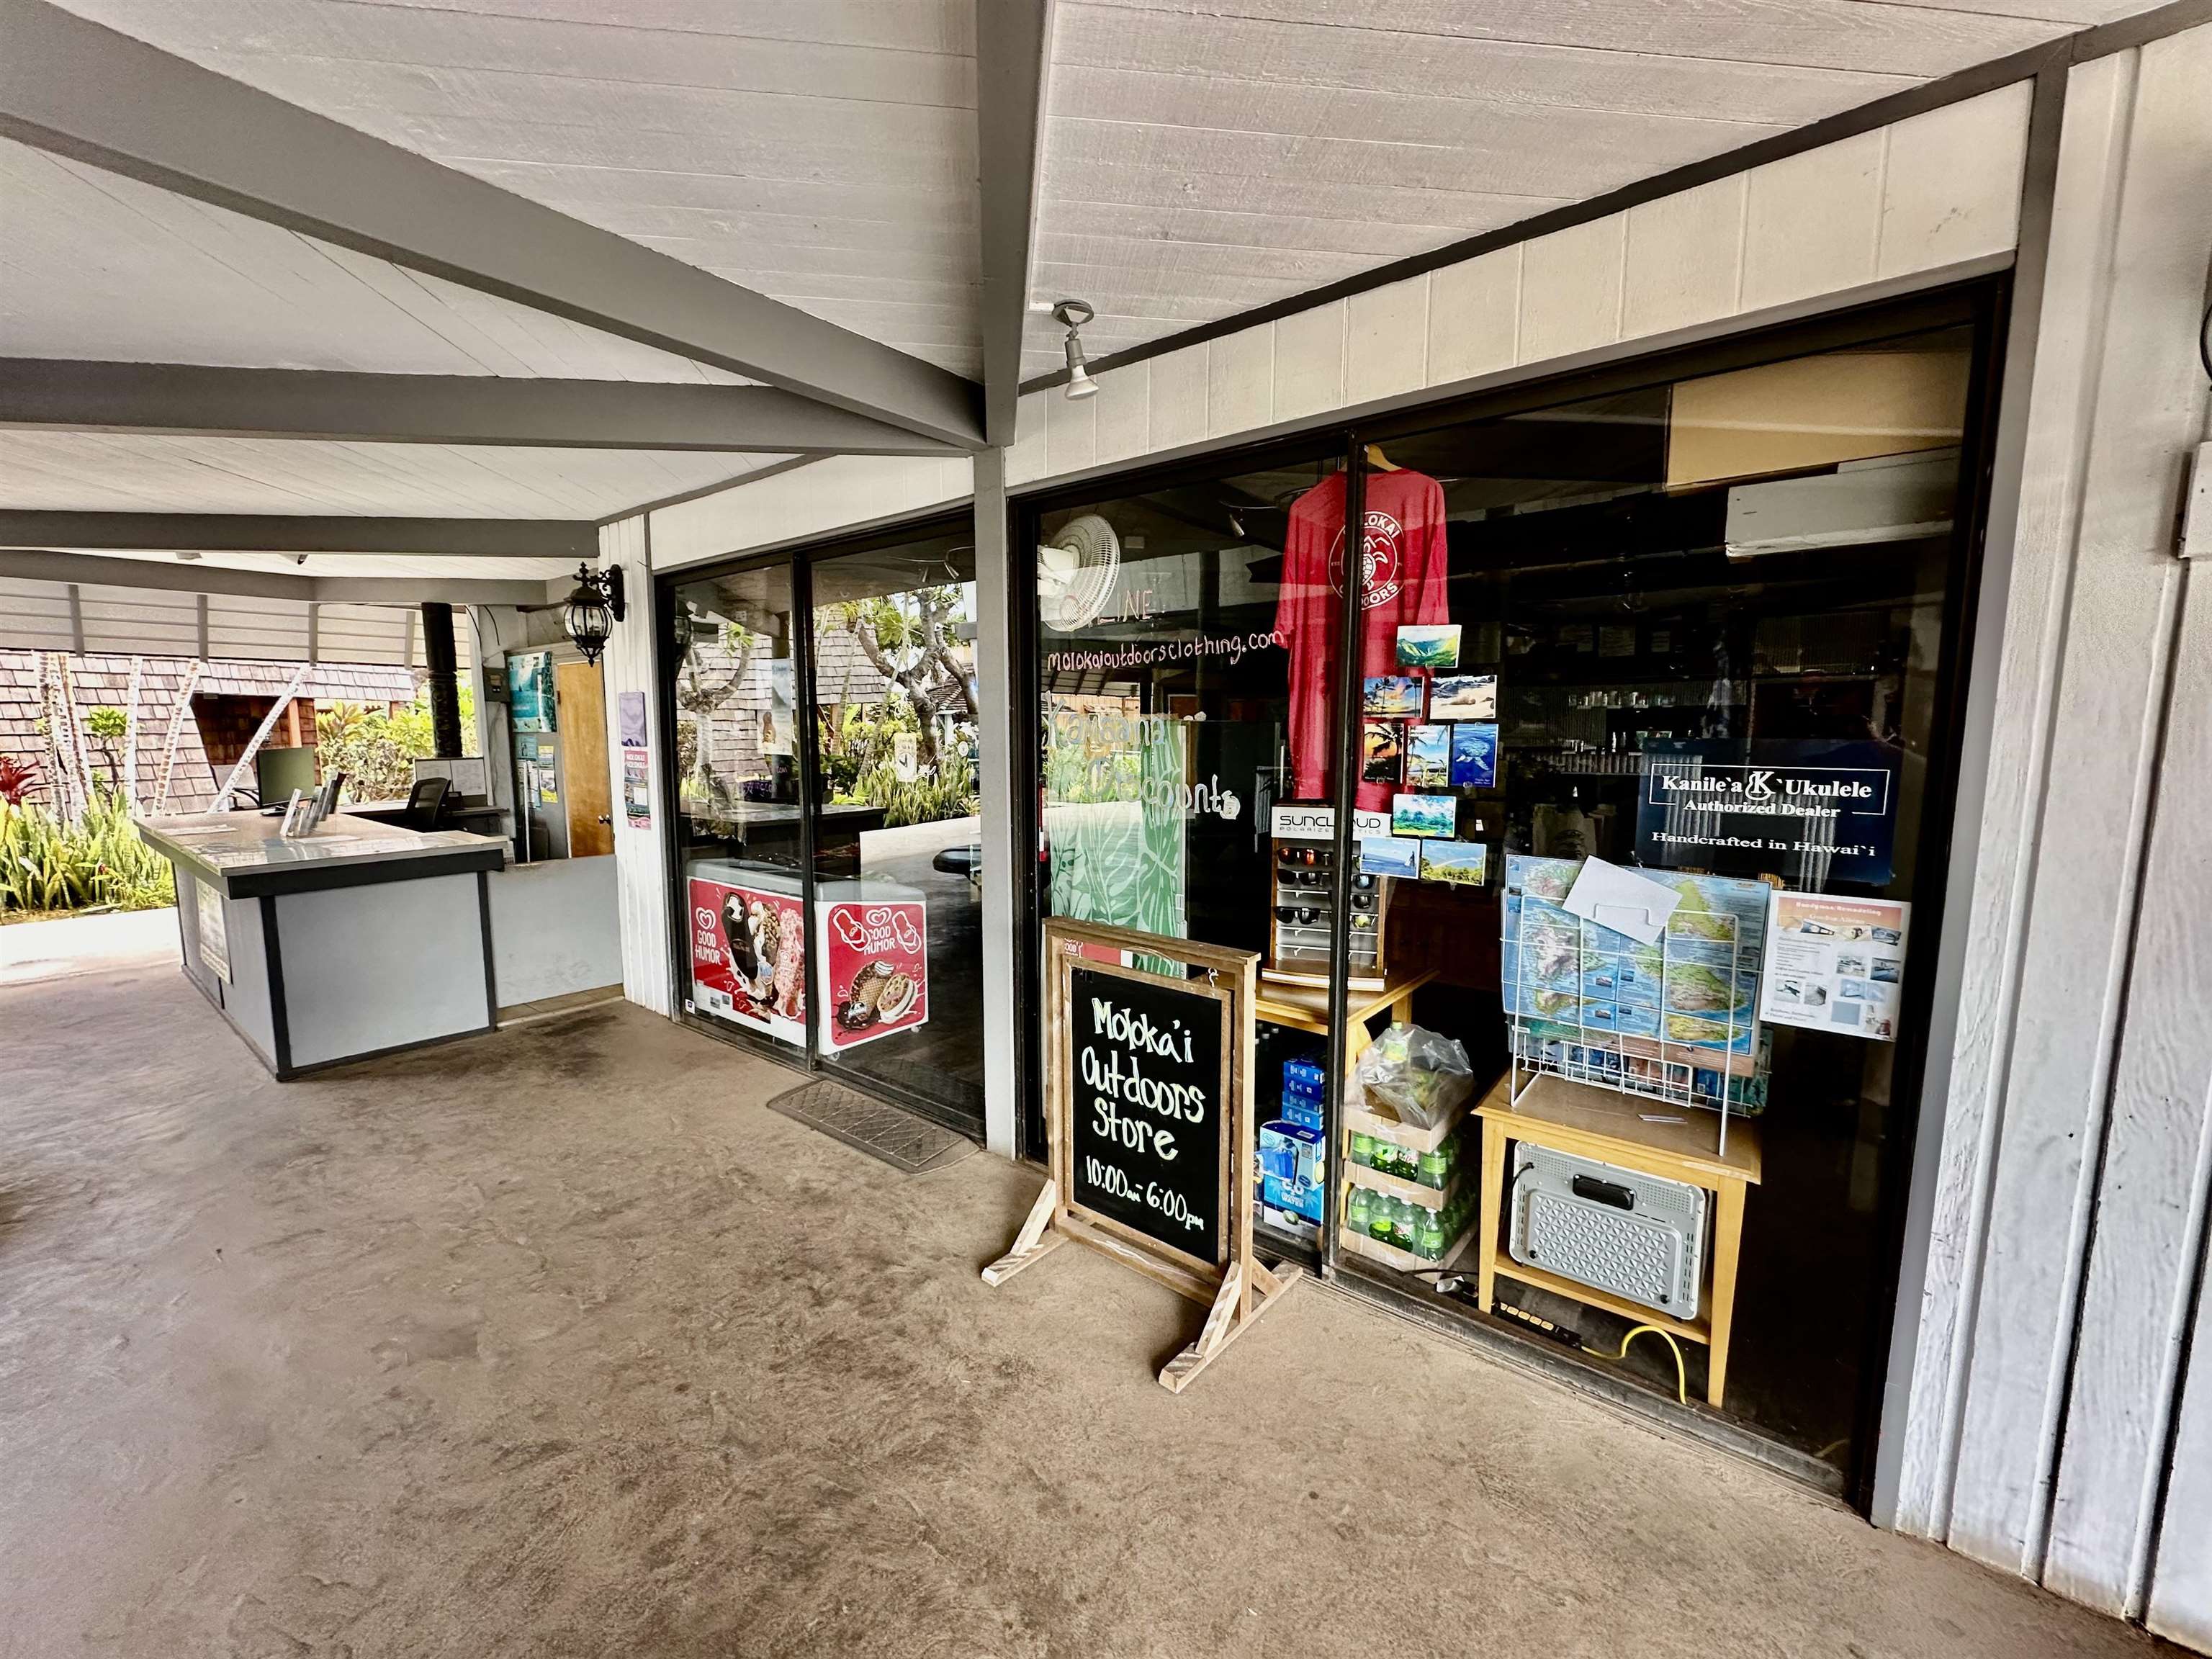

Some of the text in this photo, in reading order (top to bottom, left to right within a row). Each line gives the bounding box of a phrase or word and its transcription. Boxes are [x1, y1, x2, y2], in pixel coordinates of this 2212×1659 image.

[1683, 800, 1841, 818] Authorized Dealer
[1280, 815, 1381, 829] SUNCLUD
[1651, 832, 1763, 849] Handcrafted
[1768, 840, 1787, 850] in
[697, 930, 717, 948] GOOD
[695, 945, 722, 966] HUMOR
[1092, 997, 1194, 1063] Moloka'i
[1082, 1046, 1206, 1123] Outdoors
[1092, 1097, 1179, 1161] Store
